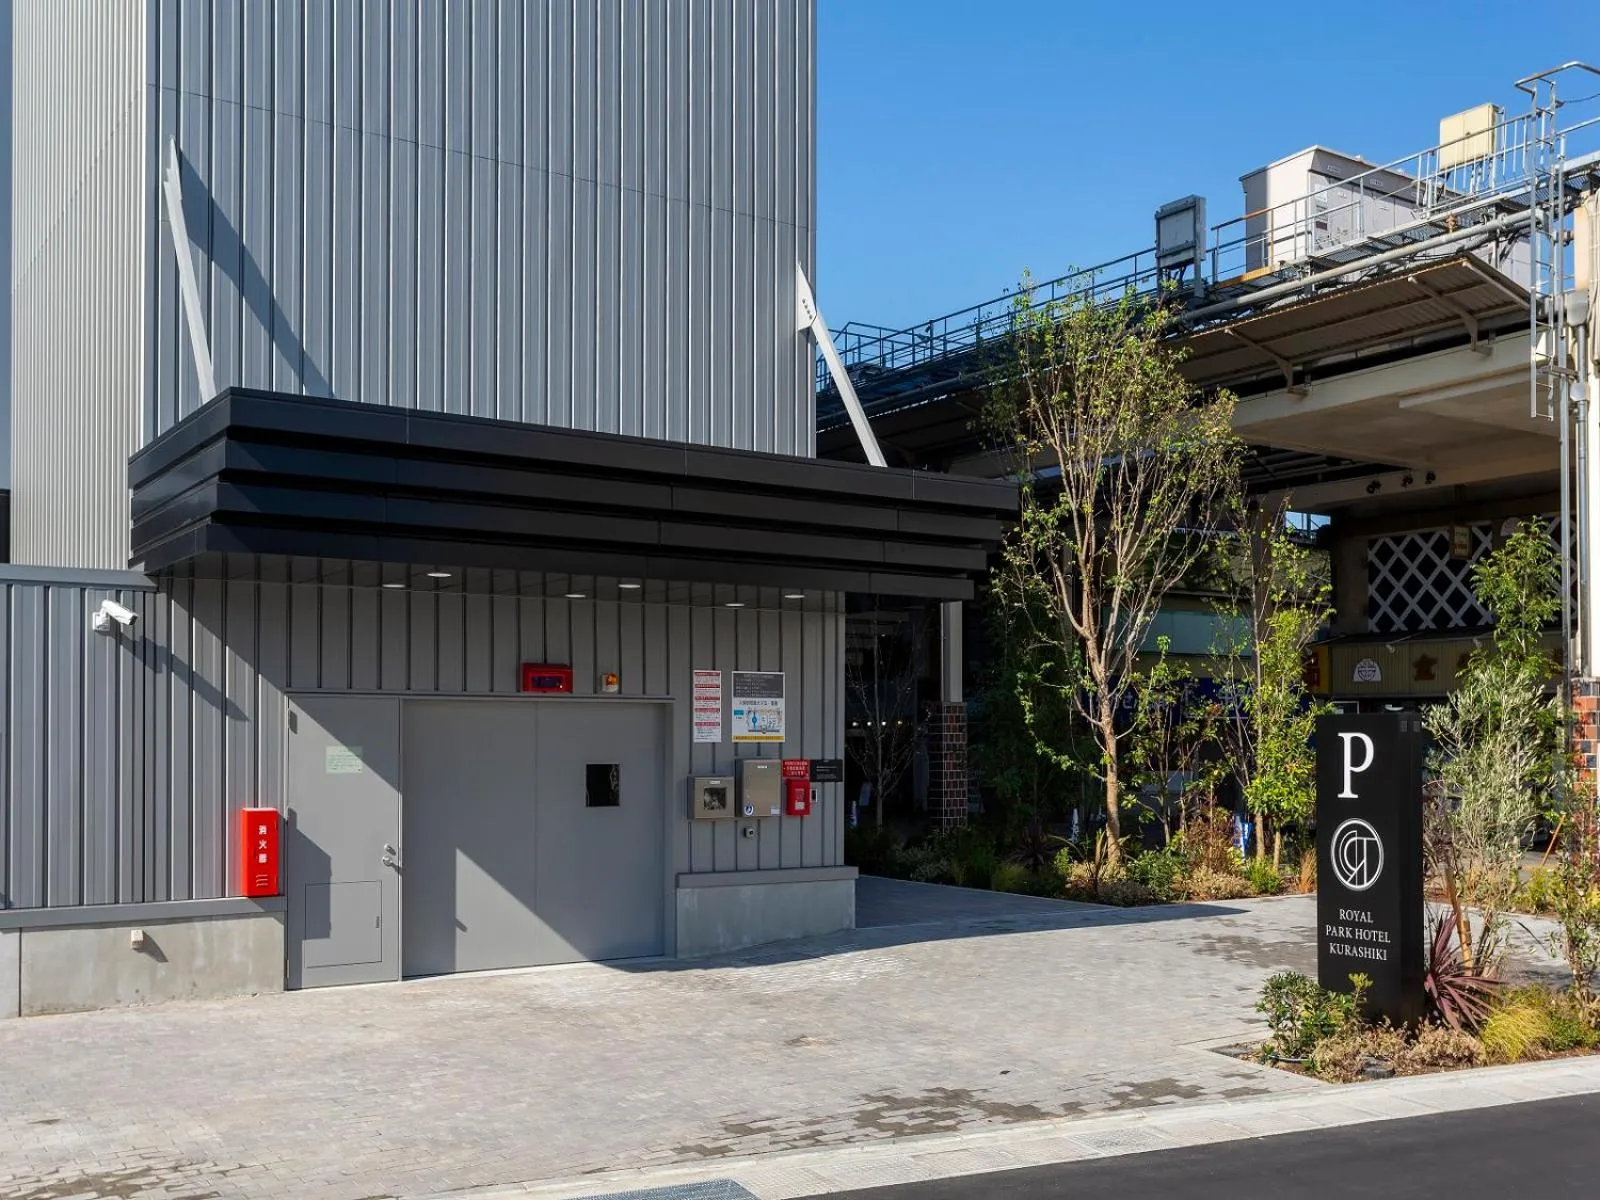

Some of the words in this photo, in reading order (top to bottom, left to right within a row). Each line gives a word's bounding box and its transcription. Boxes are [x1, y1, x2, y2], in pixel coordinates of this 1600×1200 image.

[1337, 732, 1374, 799] P
[1339, 908, 1373, 923] ROYAL
[1325, 924, 1353, 938] PARK
[1355, 928, 1391, 943] HOTEL
[1329, 942, 1388, 961] KURASHIKI
